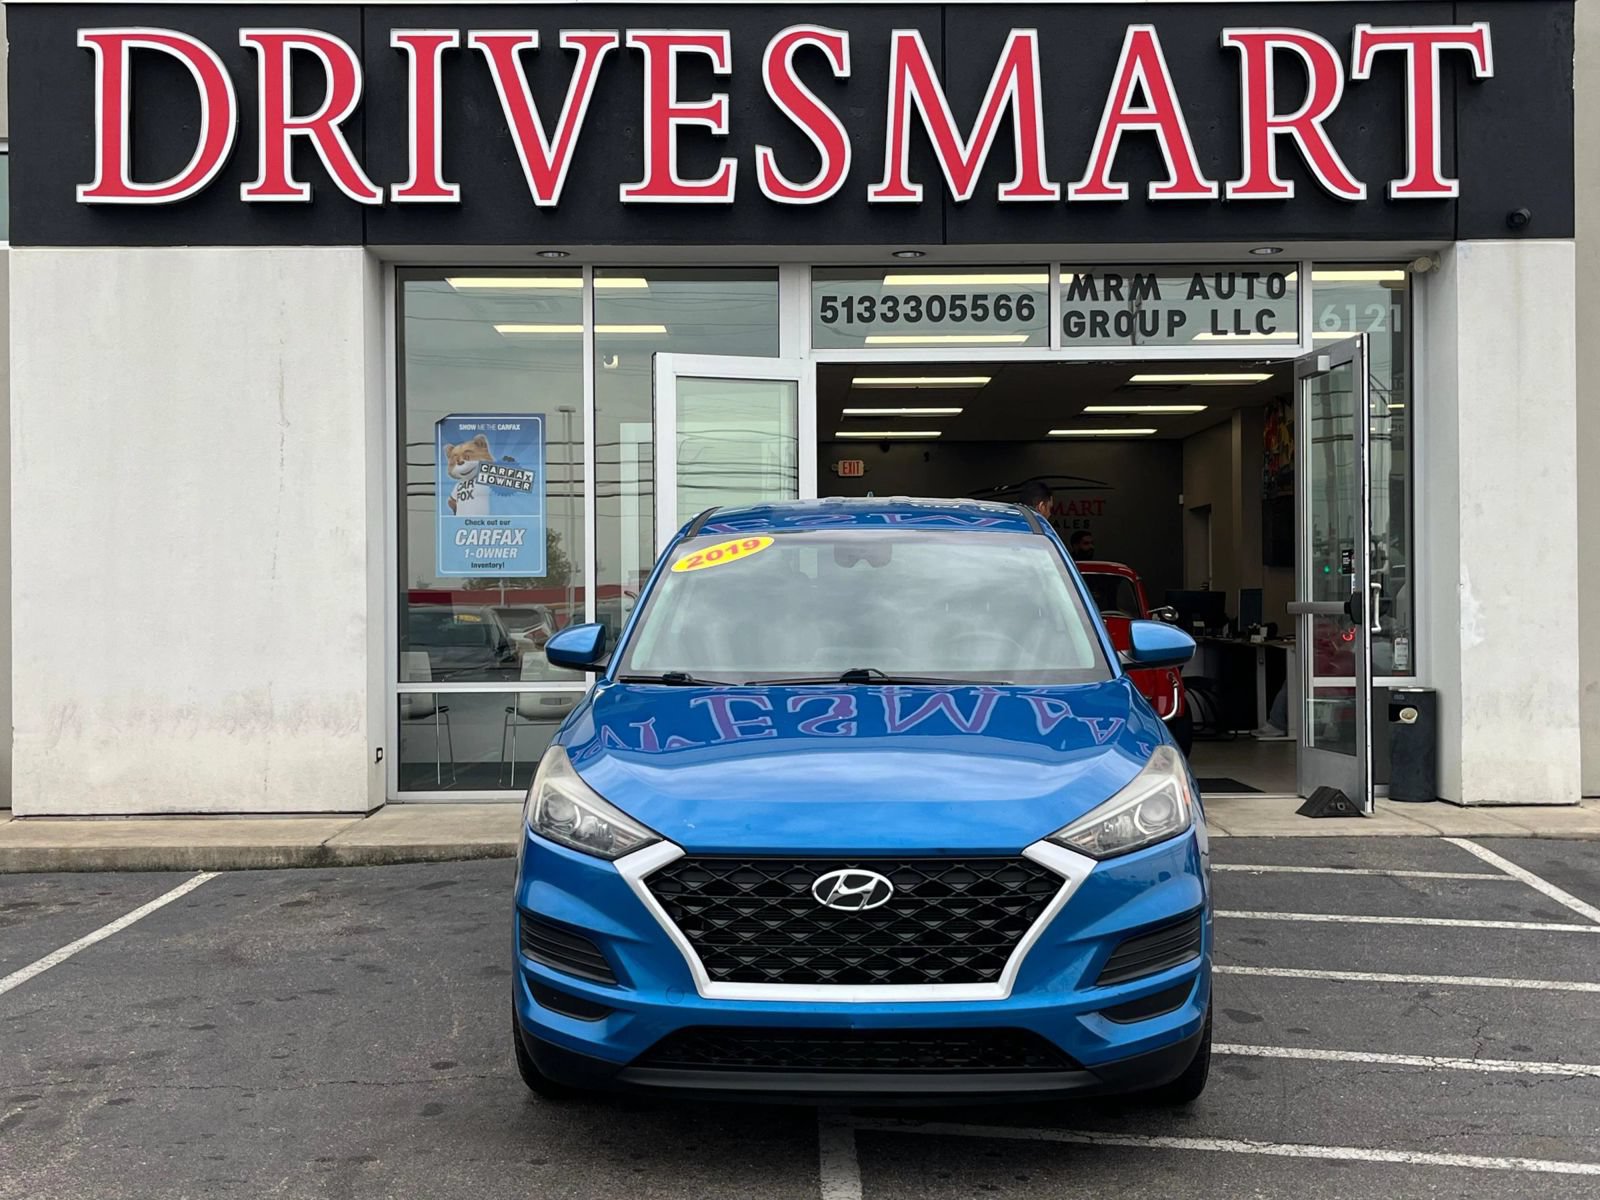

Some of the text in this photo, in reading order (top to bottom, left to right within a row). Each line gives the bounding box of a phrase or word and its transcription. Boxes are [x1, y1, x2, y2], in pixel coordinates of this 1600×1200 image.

[76, 23, 1495, 207] DRIVESMART
[1065, 272, 1287, 301] MRM AUTO
[820, 294, 1036, 324] 5133305566
[1318, 303, 1402, 333] 6121
[1062, 308, 1277, 338] GROUP LLC
[481, 463, 533, 482] CARFAX
[842, 461, 860, 475] EXIT
[456, 489, 475, 502] FOX
[1050, 497, 1106, 516] MART
[1053, 519, 1090, 529] ALES
[455, 528, 527, 546] CARFAX
[464, 548, 518, 559] 1-OWNER
[686, 539, 761, 569] 2019
[471, 561, 505, 570] Inventory!
